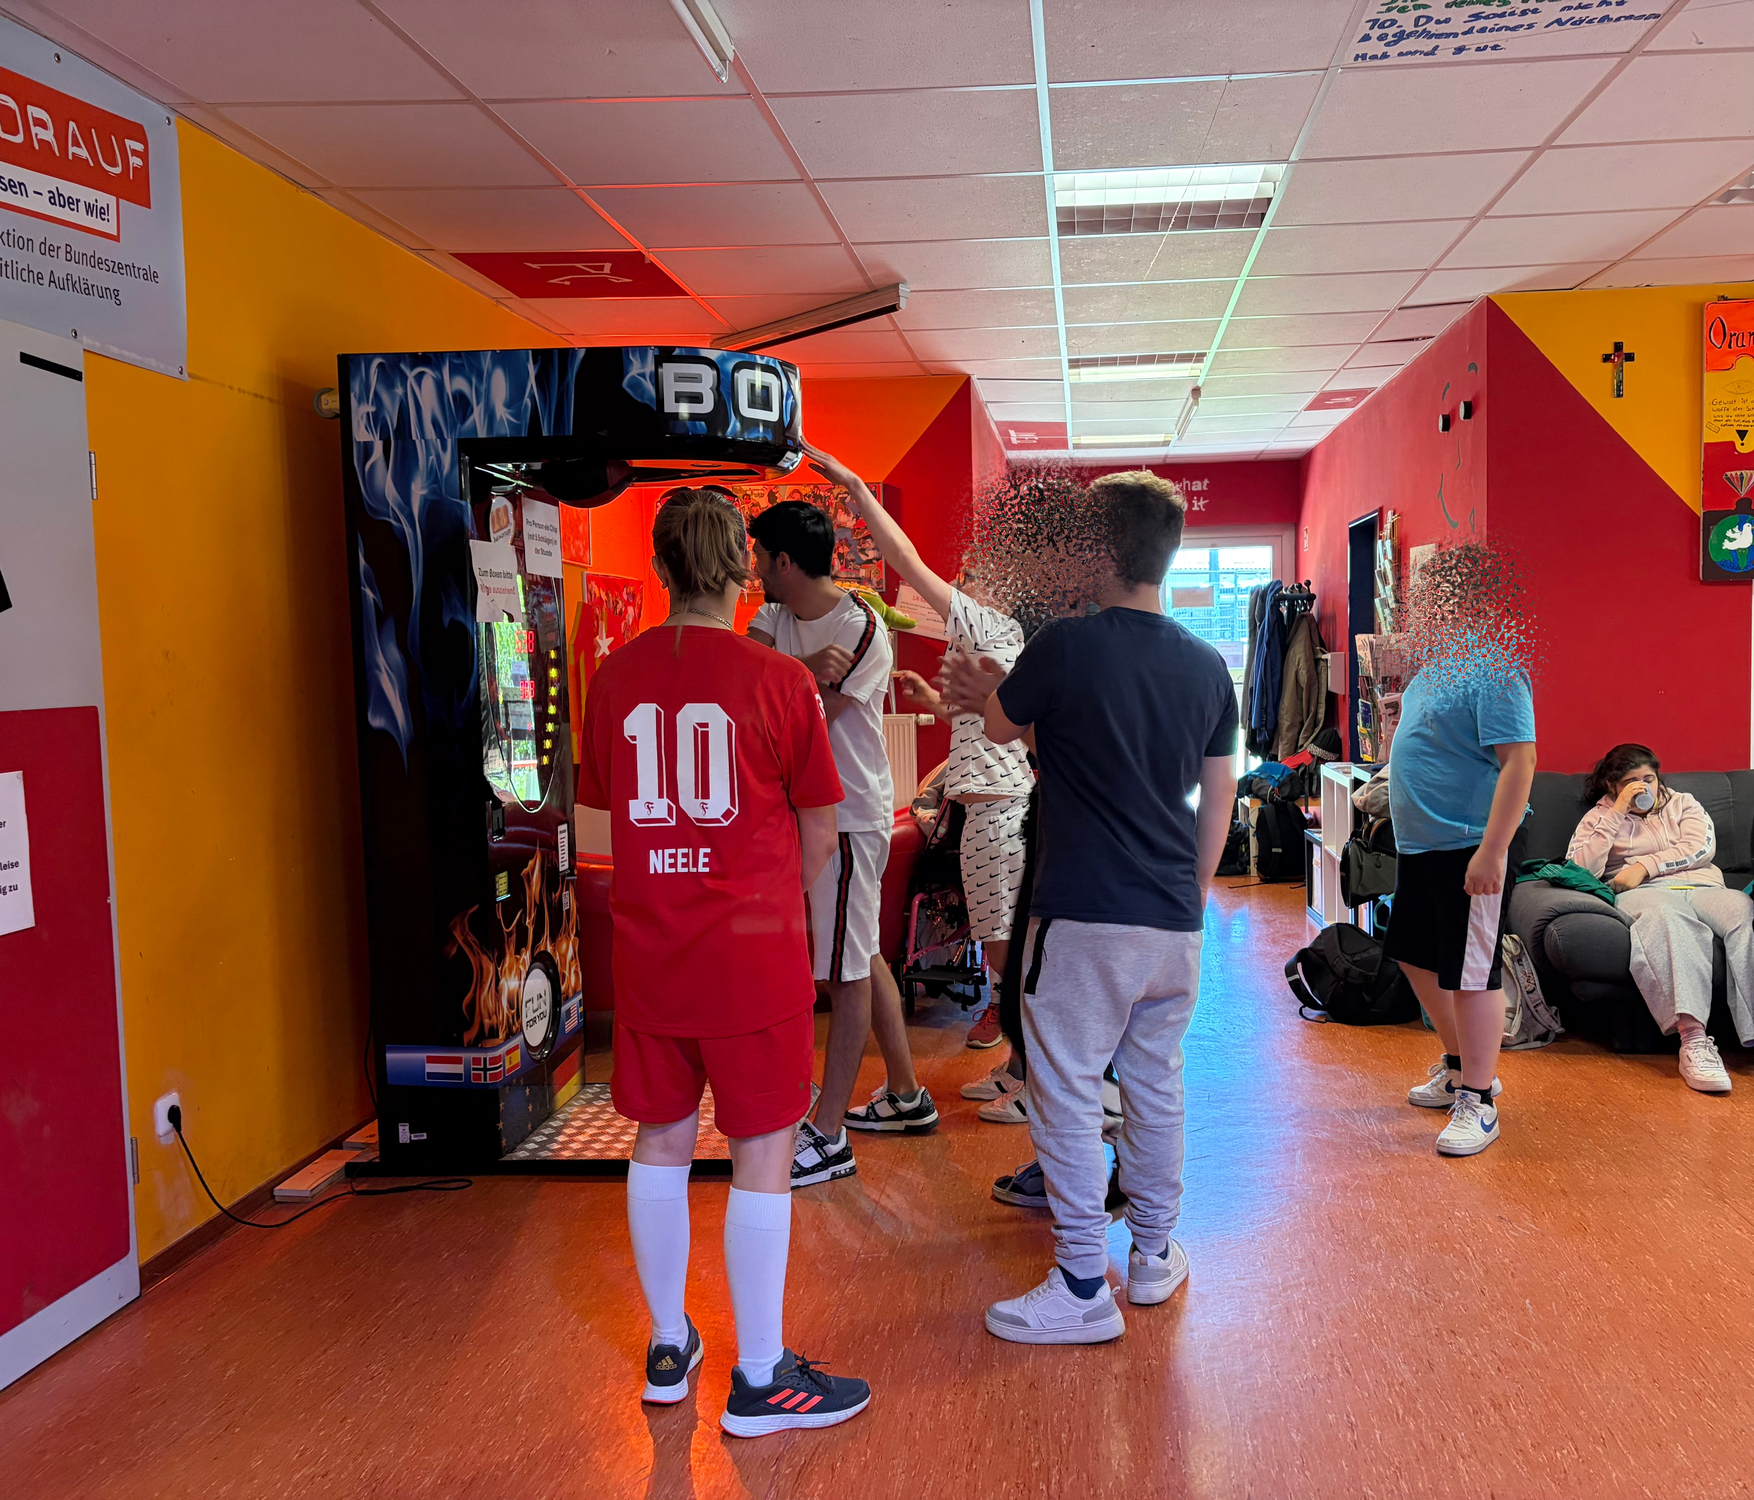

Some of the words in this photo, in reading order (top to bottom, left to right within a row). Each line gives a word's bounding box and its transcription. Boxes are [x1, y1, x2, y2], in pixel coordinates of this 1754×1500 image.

[1413, 14, 1452, 28] Du
[47, 186, 82, 214] aber
[84, 197, 111, 223] wie!
[38, 236, 62, 261] der
[64, 243, 160, 285] Bundeszentrale
[48, 268, 122, 307] Aufklärung
[489, 568, 503, 579] Boxen
[502, 570, 513, 580] bitte
[623, 703, 739, 827] 10
[649, 848, 711, 874] NEELE
[8, 883, 19, 893] zu
[525, 1015, 538, 1031] FOR
[537, 1009, 548, 1022] YOU
